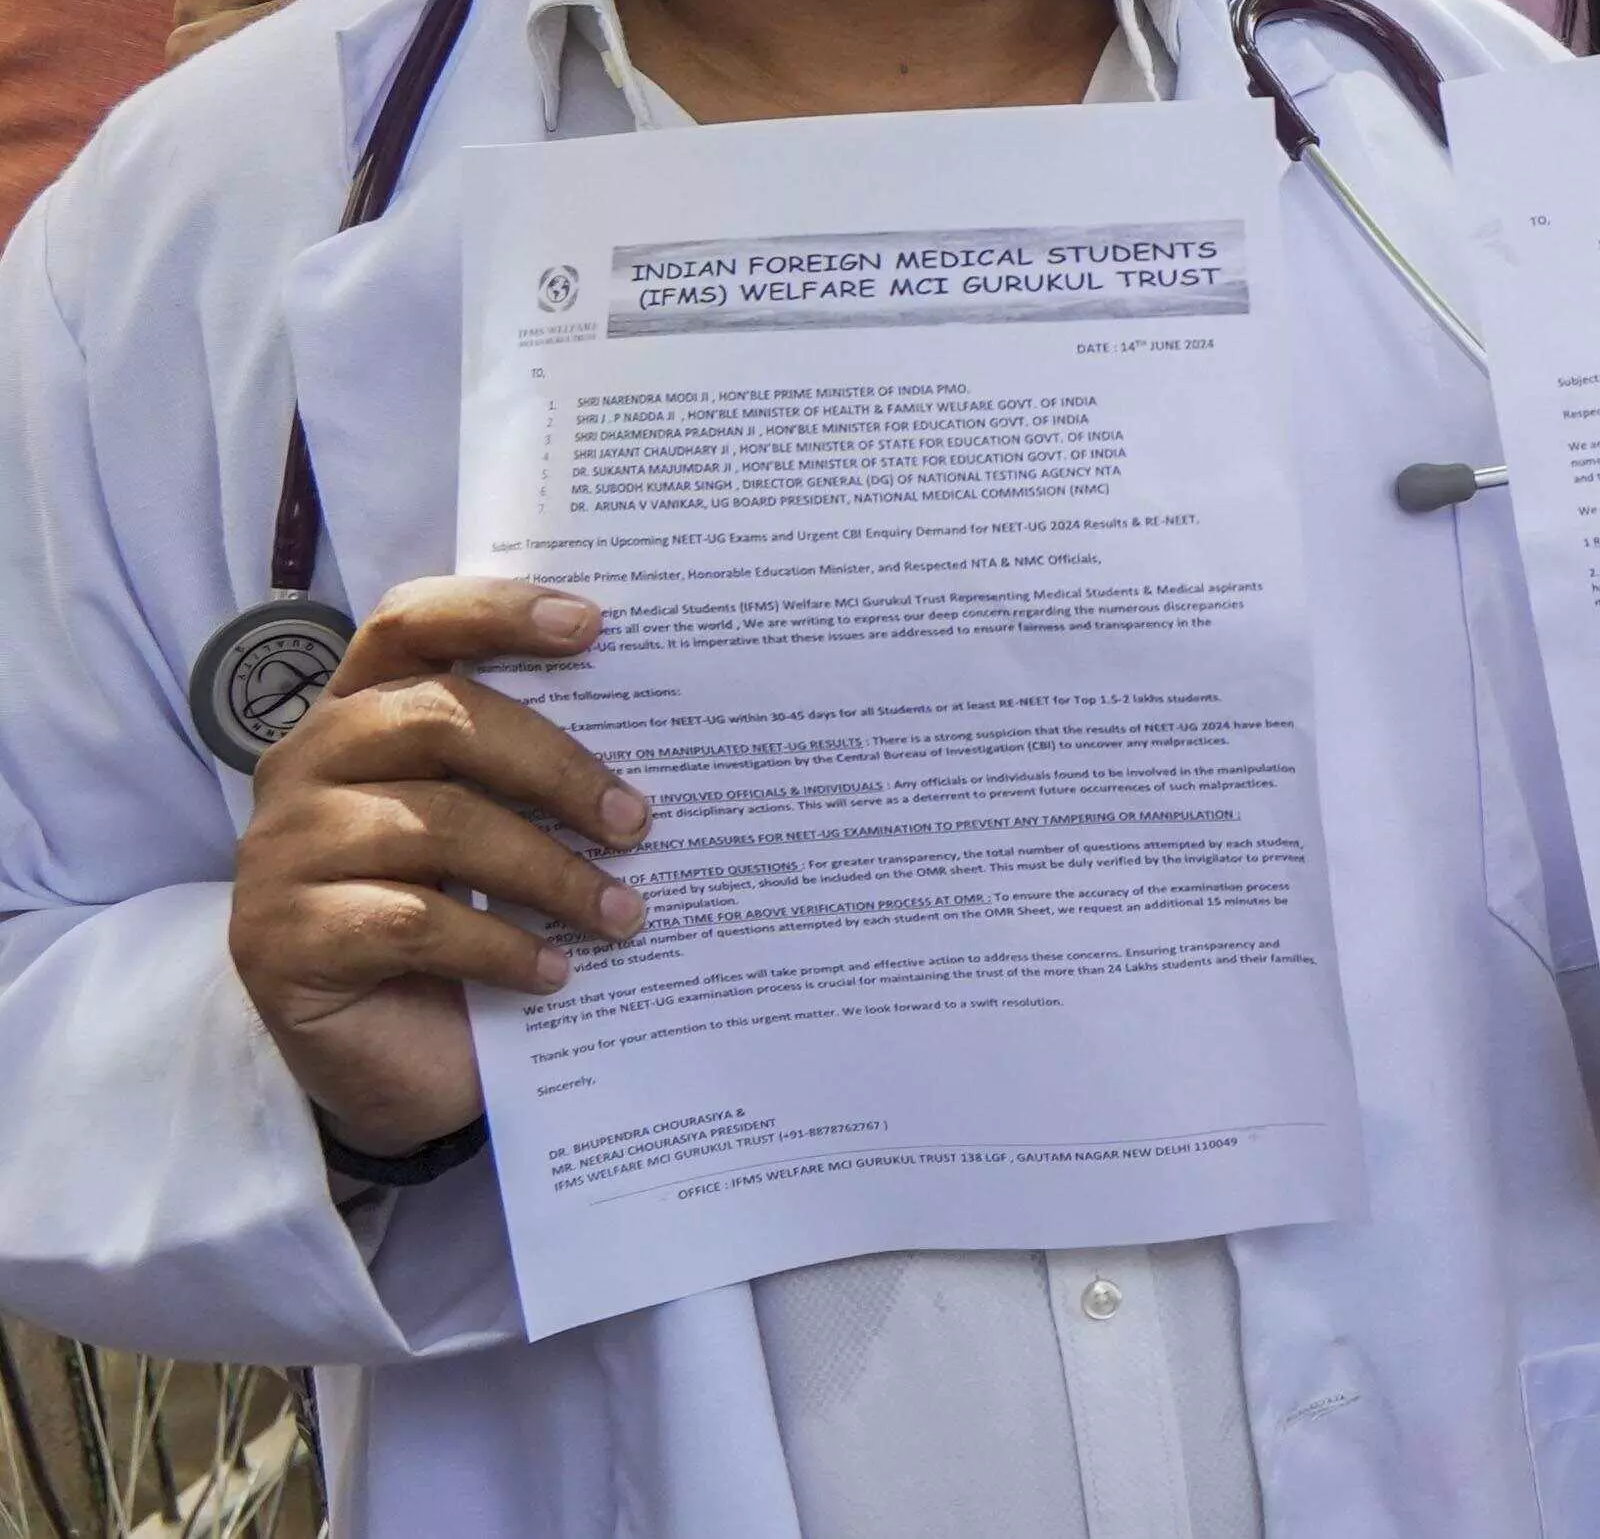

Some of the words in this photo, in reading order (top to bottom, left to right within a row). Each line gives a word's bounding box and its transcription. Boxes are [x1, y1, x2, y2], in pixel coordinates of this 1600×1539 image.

[630, 258, 735, 281] INDIAN
[749, 252, 881, 275] FOREIGN
[895, 247, 1032, 269] MEDICAL
[1047, 241, 1217, 264] STUDENTS
[639, 284, 726, 310] (IFMS)
[740, 278, 874, 301] WELFARE
[889, 277, 948, 296] MCI
[963, 272, 1103, 293] GURUKUL
[1115, 267, 1220, 287] TRUST
[570, 501, 588, 512] DR.
[594, 500, 635, 510] ARUNA
[638, 500, 646, 510] V
[651, 498, 707, 509] VANIKAR,
[711, 497, 729, 508] UG
[732, 495, 776, 507] BOARD
[779, 494, 849, 505] PRESIDENT,
[854, 491, 917, 502] NATIONAL
[921, 489, 977, 500] MEDICAL
[980, 485, 1065, 498] COMMISSION
[1069, 483, 1109, 496] (NMC)
[1578, 506, 1596, 515] We
[530, 1047, 568, 1064] Thank
[572, 1044, 594, 1056] you
[597, 1039, 615, 1048] for
[619, 1033, 647, 1047] your
[650, 1023, 707, 1039] attention
[709, 1021, 723, 1029] to
[725, 1017, 748, 1027] this
[751, 1012, 792, 1024] urgent
[794, 1010, 840, 1019] matter.
[841, 1007, 861, 1015] We
[864, 1004, 890, 1014] look
[894, 1000, 940, 1011] forward
[970, 998, 998, 1007] swift
[1001, 996, 1063, 1007] resolution.
[537, 1076, 595, 1096] Sincerely,
[548, 1147, 568, 1160] DR.
[572, 1127, 649, 1153] BHUPENDRA
[652, 1110, 732, 1133] CHOURASIYA
[736, 1108, 745, 1117] &
[551, 1162, 576, 1175] MR.
[579, 1148, 624, 1168] NEERAJ
[627, 1130, 707, 1155] CHOURASIYA
[710, 1118, 775, 1137] PRESIDENT
[554, 1175, 584, 1191] IFMS
[586, 1159, 641, 1182] WELFARE
[647, 1153, 670, 1166] MCI
[674, 1140, 732, 1160] GURUKUL
[735, 1132, 774, 1147] TRUST
[677, 1181, 720, 1199] OFFICE
[731, 1173, 762, 1187] IFMS
[765, 1163, 824, 1180] WELFARE
[827, 1160, 851, 1170] MCI
[855, 1155, 915, 1167] GURUKUL
[919, 1153, 955, 1163] TRUST
[961, 1152, 982, 1162] 138
[985, 1152, 1006, 1162] LGF
[1016, 1152, 1071, 1162] GAUTAM
[1075, 1150, 1119, 1160] NAGAR
[1122, 1148, 1151, 1158] NEW
[1155, 1143, 1190, 1156] DELHI
